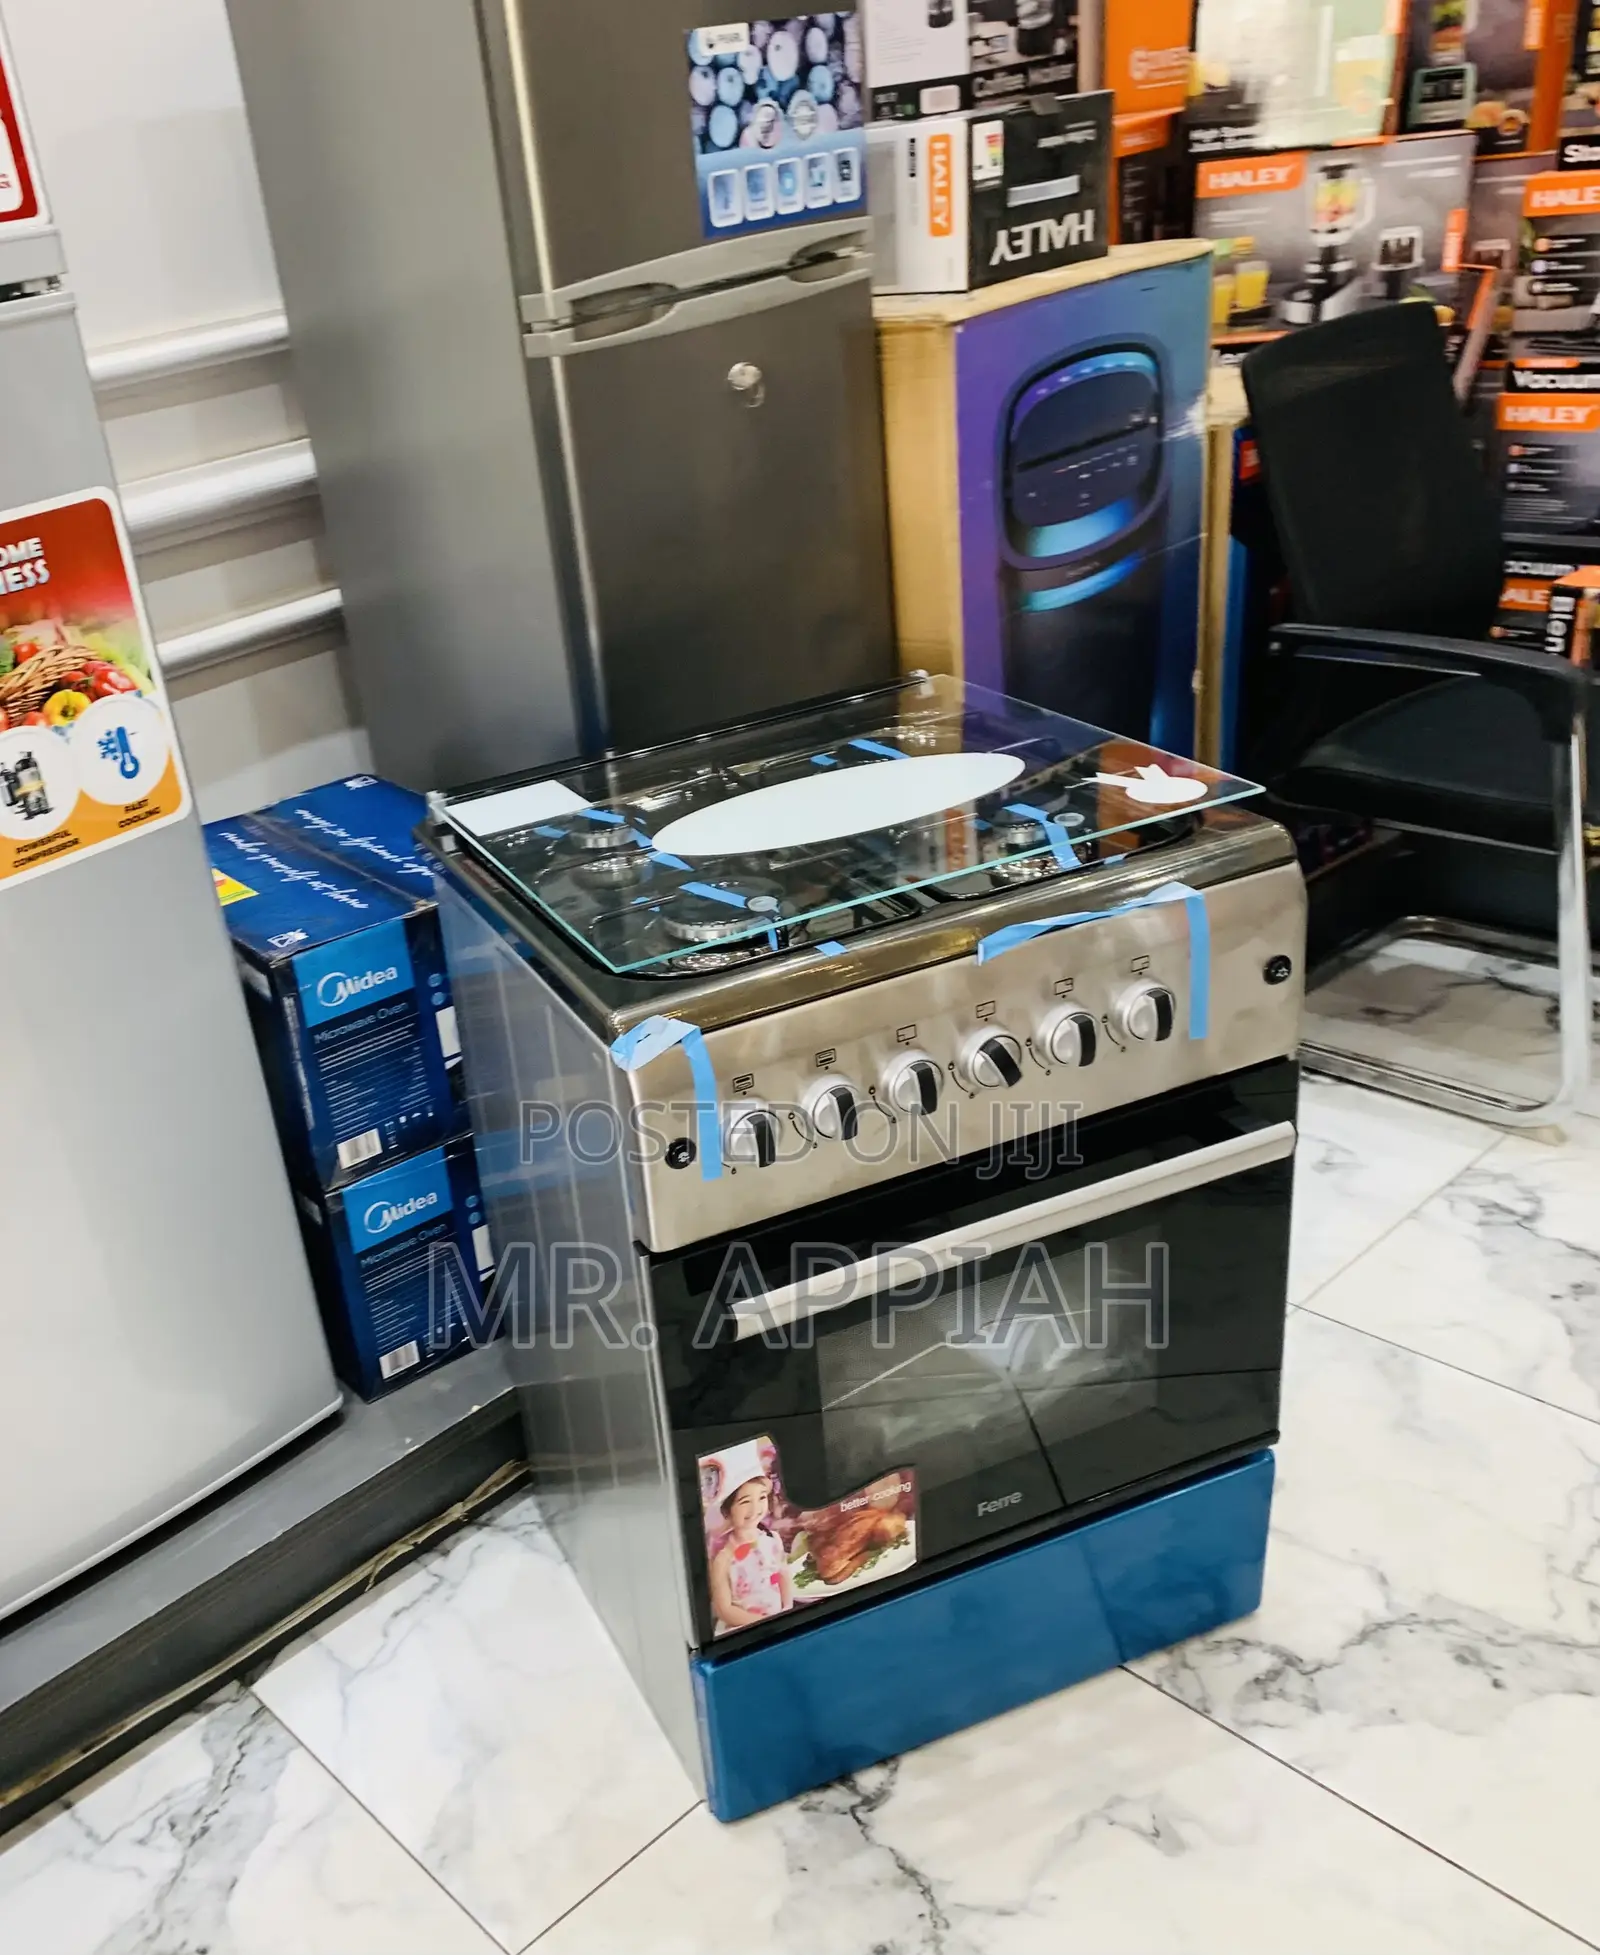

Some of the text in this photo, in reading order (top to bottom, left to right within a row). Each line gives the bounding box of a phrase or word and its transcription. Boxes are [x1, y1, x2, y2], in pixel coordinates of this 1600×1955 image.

[931, 141, 949, 229] HALEY
[1208, 163, 1297, 190] HALEY
[989, 208, 1096, 266] HALEY
[1505, 406, 1592, 424] HALEY
[118, 806, 162, 828] COOLING
[13, 837, 81, 868] COMPRESSOR
[16, 830, 72, 854] POWERFUL
[316, 966, 398, 1007] Midea
[314, 1002, 409, 1045] Microwave Oven
[363, 1191, 438, 1234] Midea
[360, 1235, 418, 1269] Microwave
[417, 1223, 448, 1242] Oven
[840, 1481, 912, 1512] better cooking
[977, 1490, 1024, 1517] Ferre
